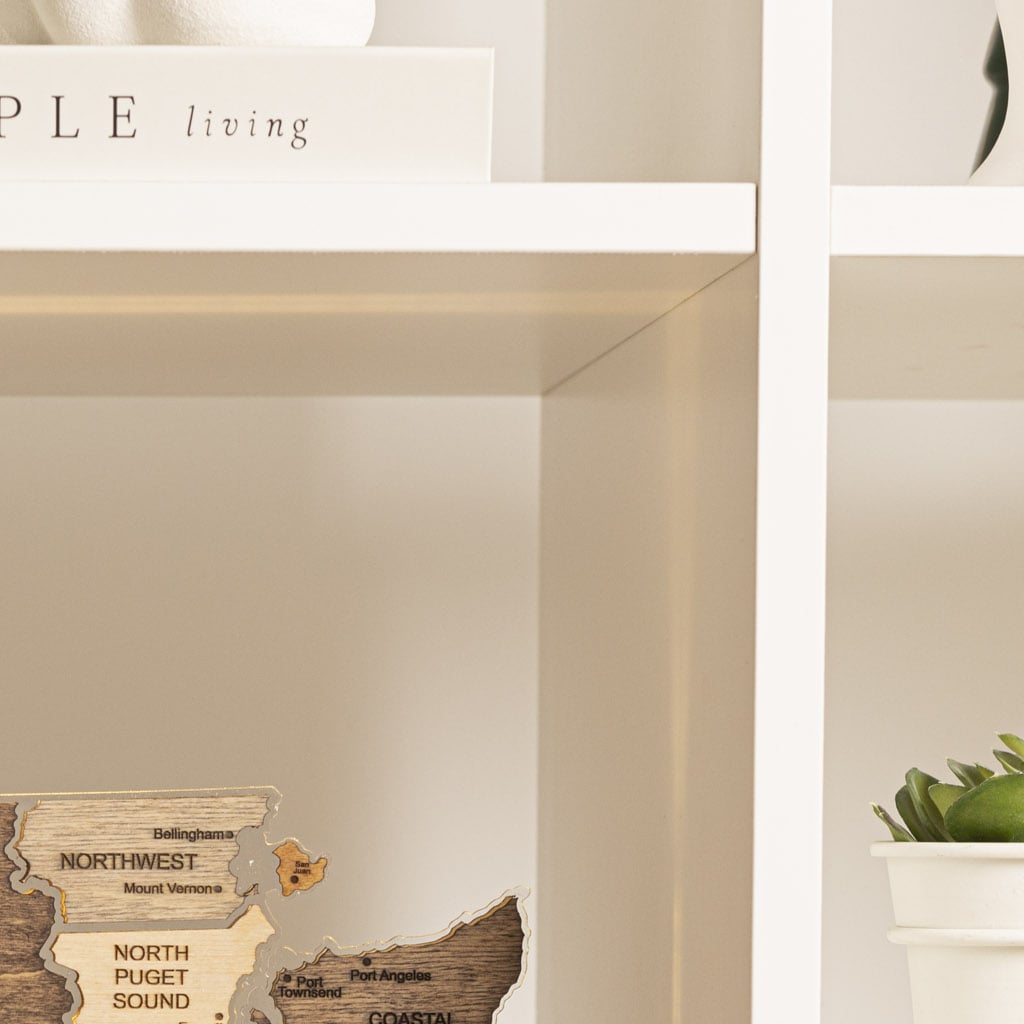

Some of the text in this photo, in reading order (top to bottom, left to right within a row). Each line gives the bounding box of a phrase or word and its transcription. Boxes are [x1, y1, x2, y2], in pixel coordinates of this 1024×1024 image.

[186, 106, 309, 149] living
[153, 828, 225, 842] Bellingham
[60, 853, 198, 870] NORTHWEST
[124, 883, 213, 894] Mount Vernon
[114, 945, 189, 961] NORTH
[115, 968, 189, 986] PUGET
[297, 976, 324, 988] Port
[350, 969, 432, 983] Port Angeles
[278, 987, 342, 998] Townsend
[113, 993, 190, 1010] SOUND
